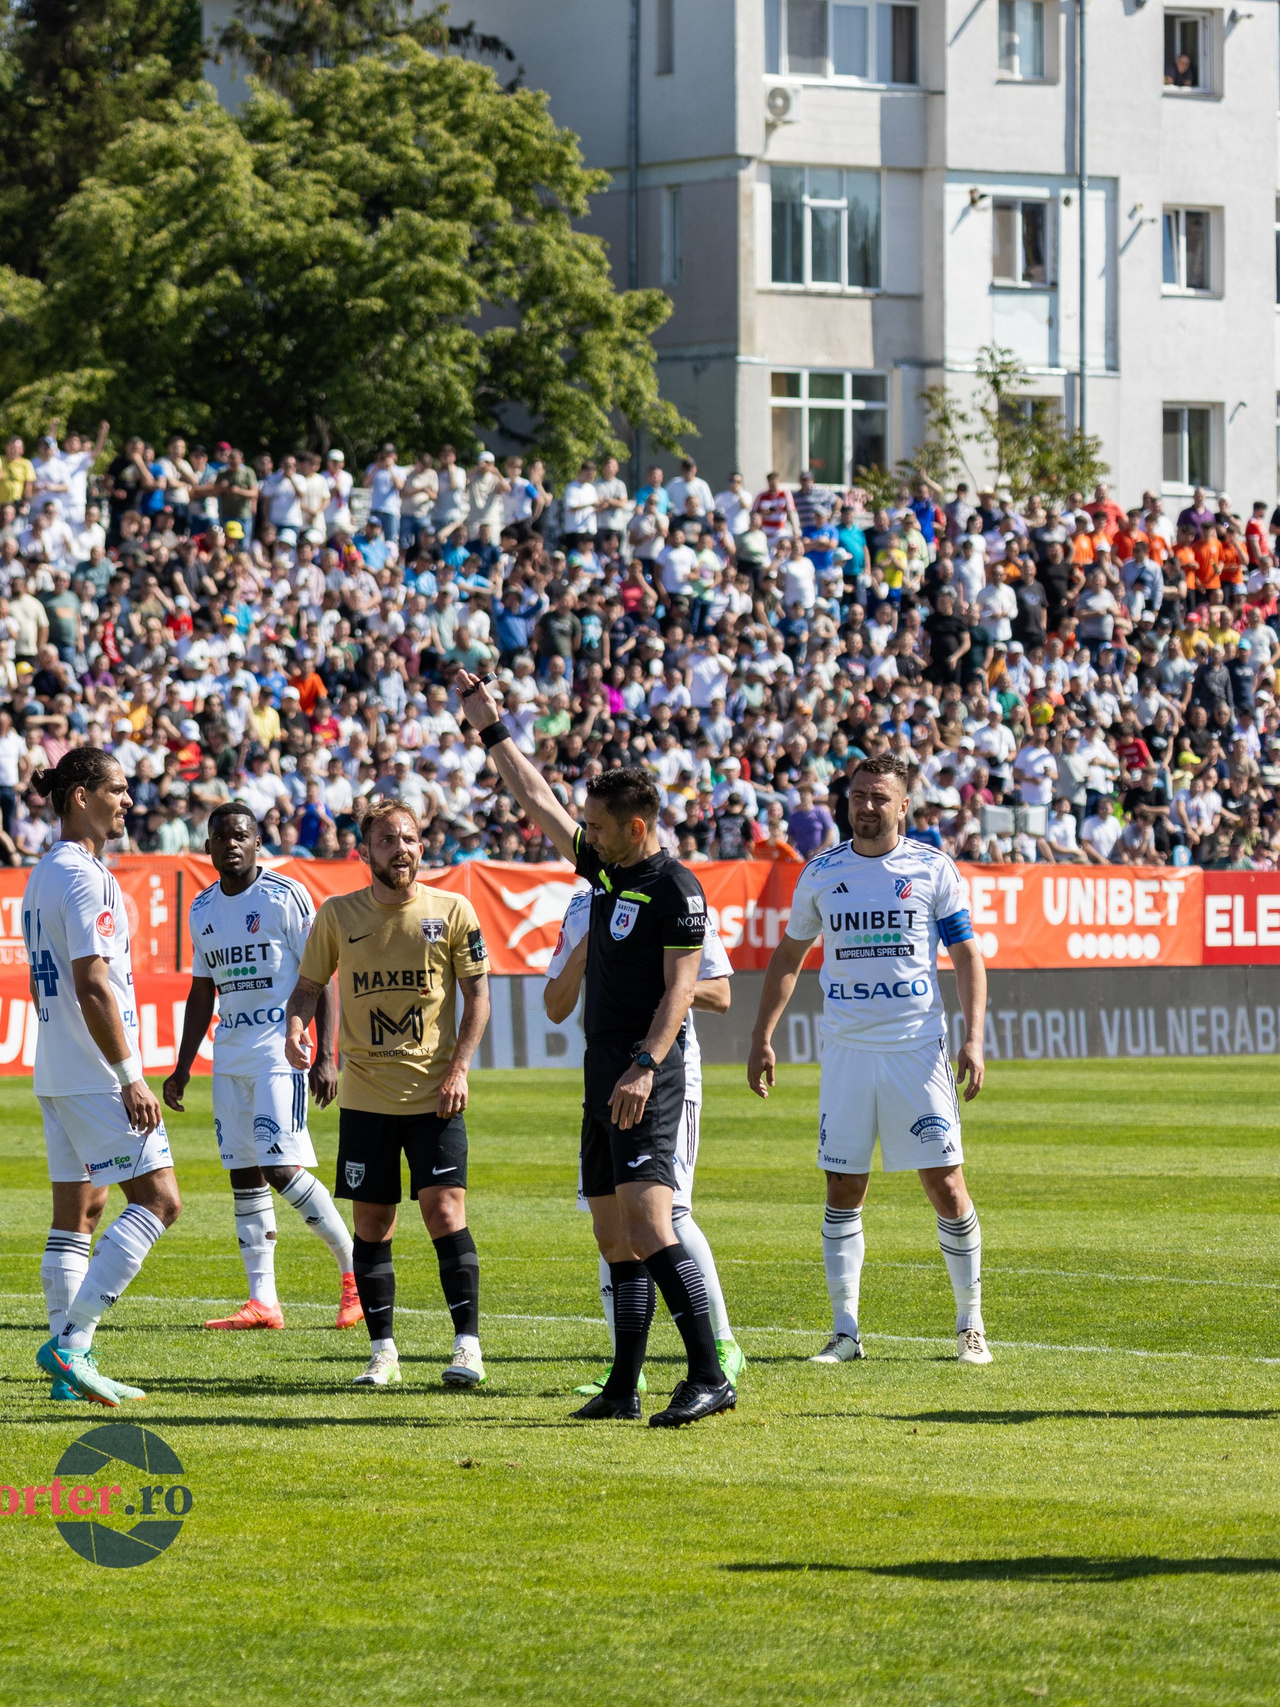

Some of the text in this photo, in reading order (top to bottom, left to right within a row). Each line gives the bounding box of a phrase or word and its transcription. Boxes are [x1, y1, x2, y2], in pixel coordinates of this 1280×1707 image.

[1042, 877, 1185, 926] UNIBET
[830, 909, 917, 932] UNIBET
[204, 942, 271, 969] UNIBET
[877, 947, 896, 957] SPRE
[898, 946, 911, 956] 0%
[237, 980, 255, 991] SPRE
[256, 979, 269, 989] 0%
[352, 968, 436, 994] MAXBET
[827, 979, 928, 1000] ELSACO
[1100, 1005, 1280, 1058] VULNERAB
[90, 1155, 131, 1172] Smart Eco
[118, 1162, 133, 1170] Plus
[824, 1155, 847, 1165] Vestra
